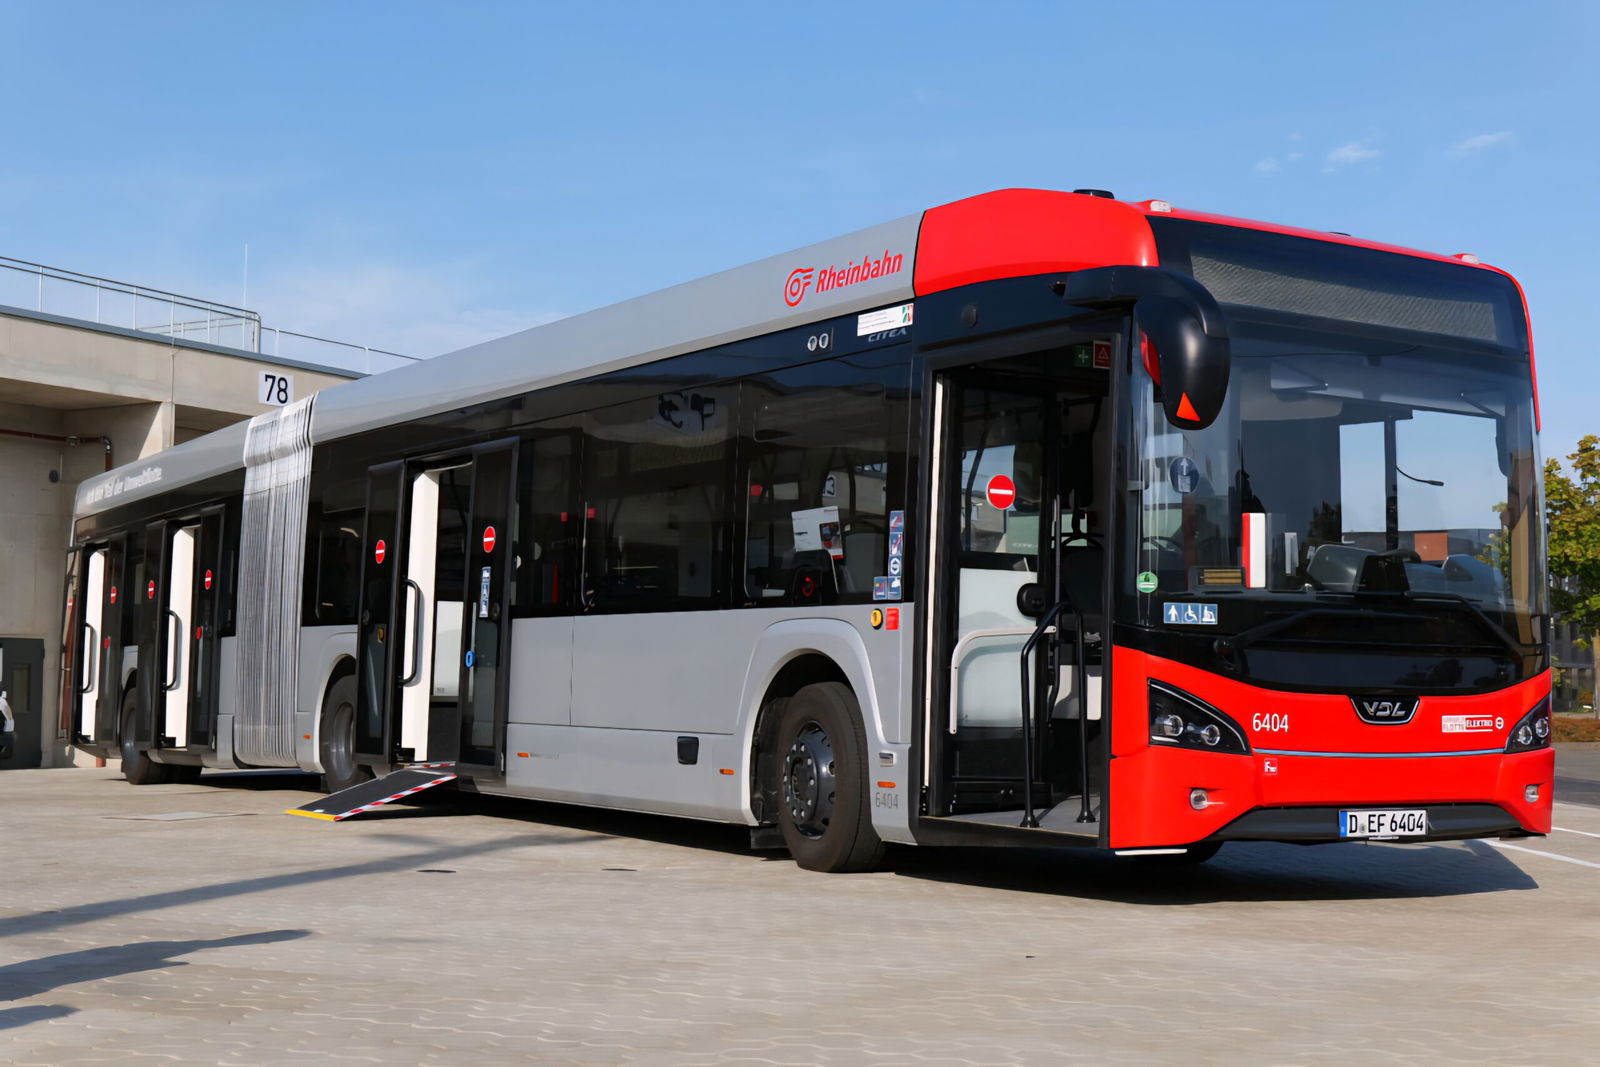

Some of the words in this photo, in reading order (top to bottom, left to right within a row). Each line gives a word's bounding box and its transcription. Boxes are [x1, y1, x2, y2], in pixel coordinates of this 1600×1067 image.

[816, 249, 903, 293] Rheinbahn
[265, 374, 288, 404] 78
[1363, 701, 1406, 717] VDL
[1253, 712, 1289, 732] 6404
[875, 791, 898, 808] 6404
[1349, 814, 1358, 833] D
[1368, 813, 1386, 832] EF
[1390, 813, 1424, 832] 6404
